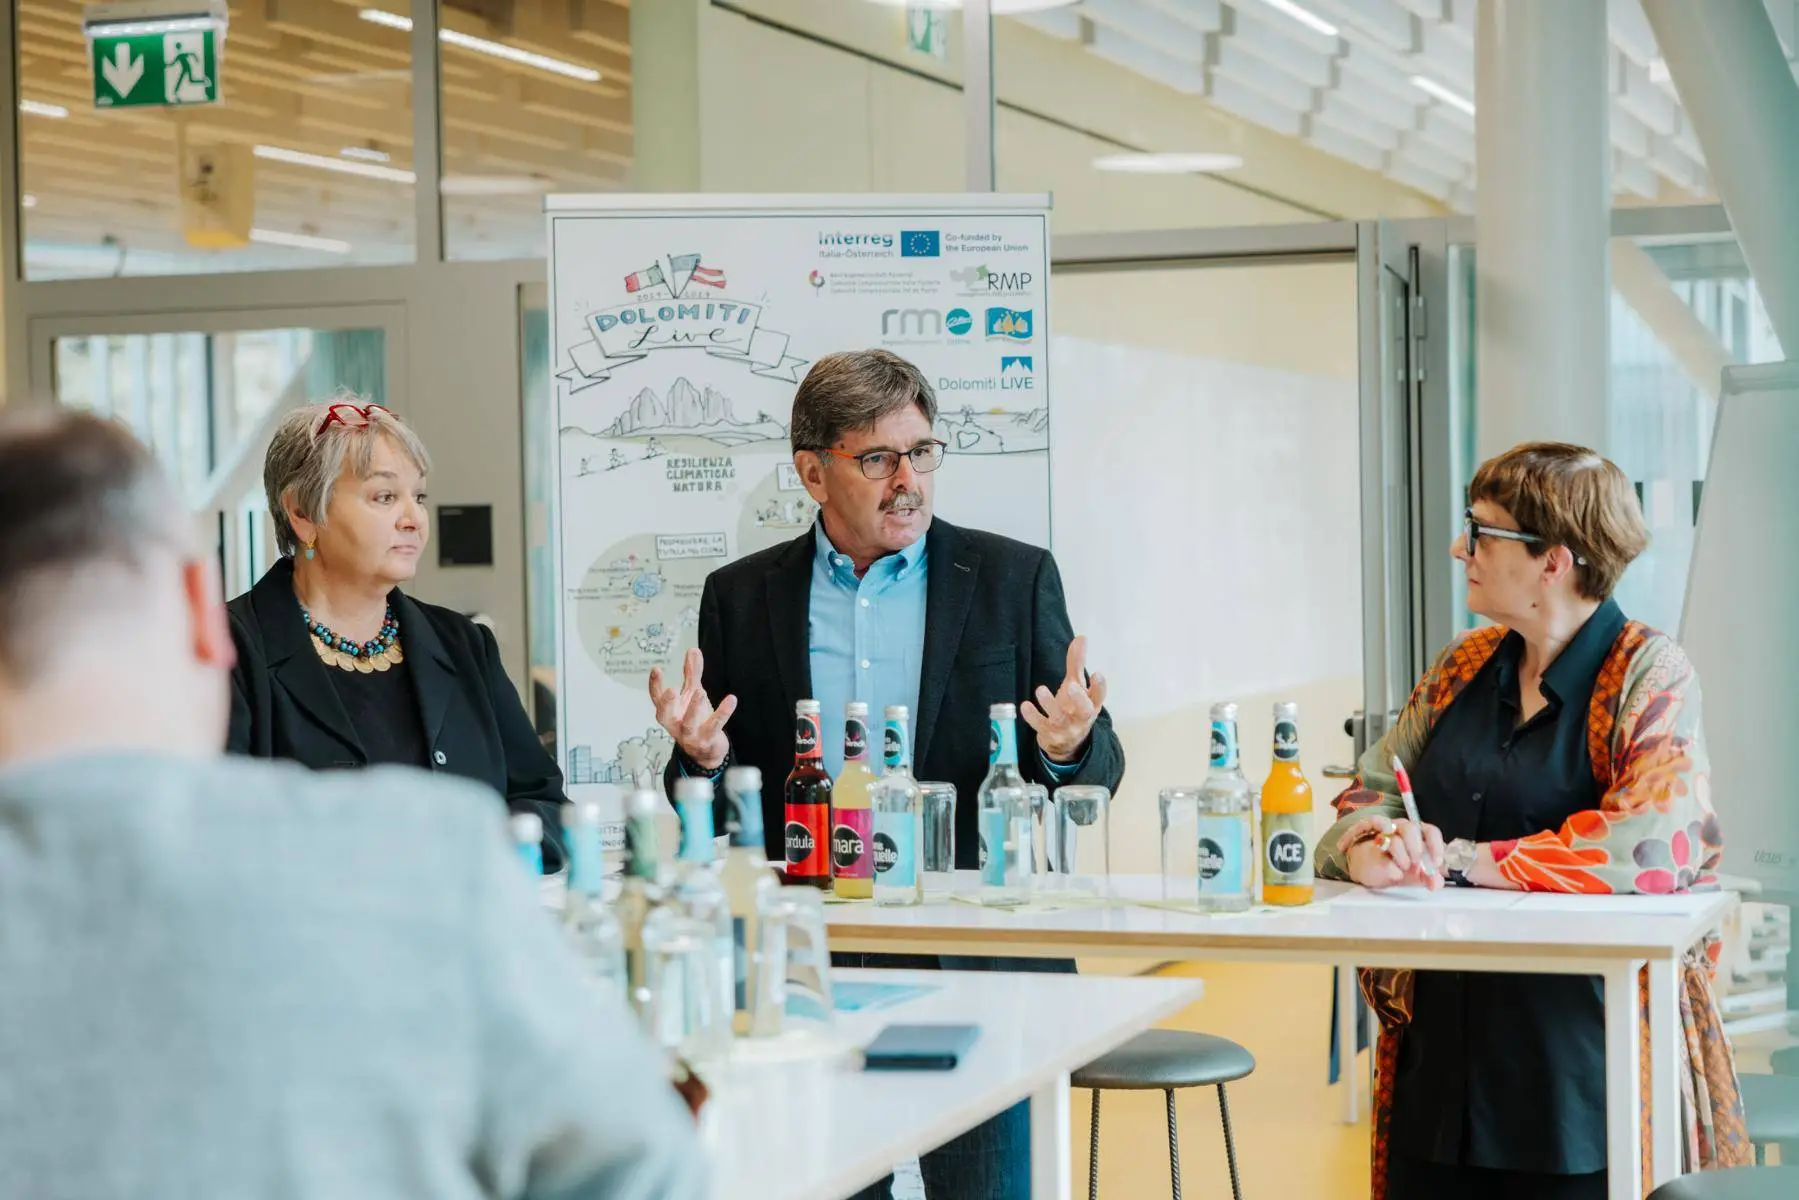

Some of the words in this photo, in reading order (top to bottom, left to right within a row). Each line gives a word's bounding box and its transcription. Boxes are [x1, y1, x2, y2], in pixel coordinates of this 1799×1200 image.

[818, 231, 894, 248] Interreg
[945, 233, 990, 242] Co-funded
[992, 233, 1002, 243] by
[945, 244, 959, 252] the
[961, 244, 1001, 254] European
[1003, 244, 1029, 252] Union
[987, 272, 1033, 290] RMP
[595, 304, 751, 332] DOLOMITI
[628, 325, 742, 349] Live
[938, 377, 996, 390] Dolomiti
[1001, 377, 1034, 390] LIVE
[666, 456, 733, 469] RESILIENZA
[673, 482, 723, 493] NATURA
[1274, 843, 1302, 862] ACE
